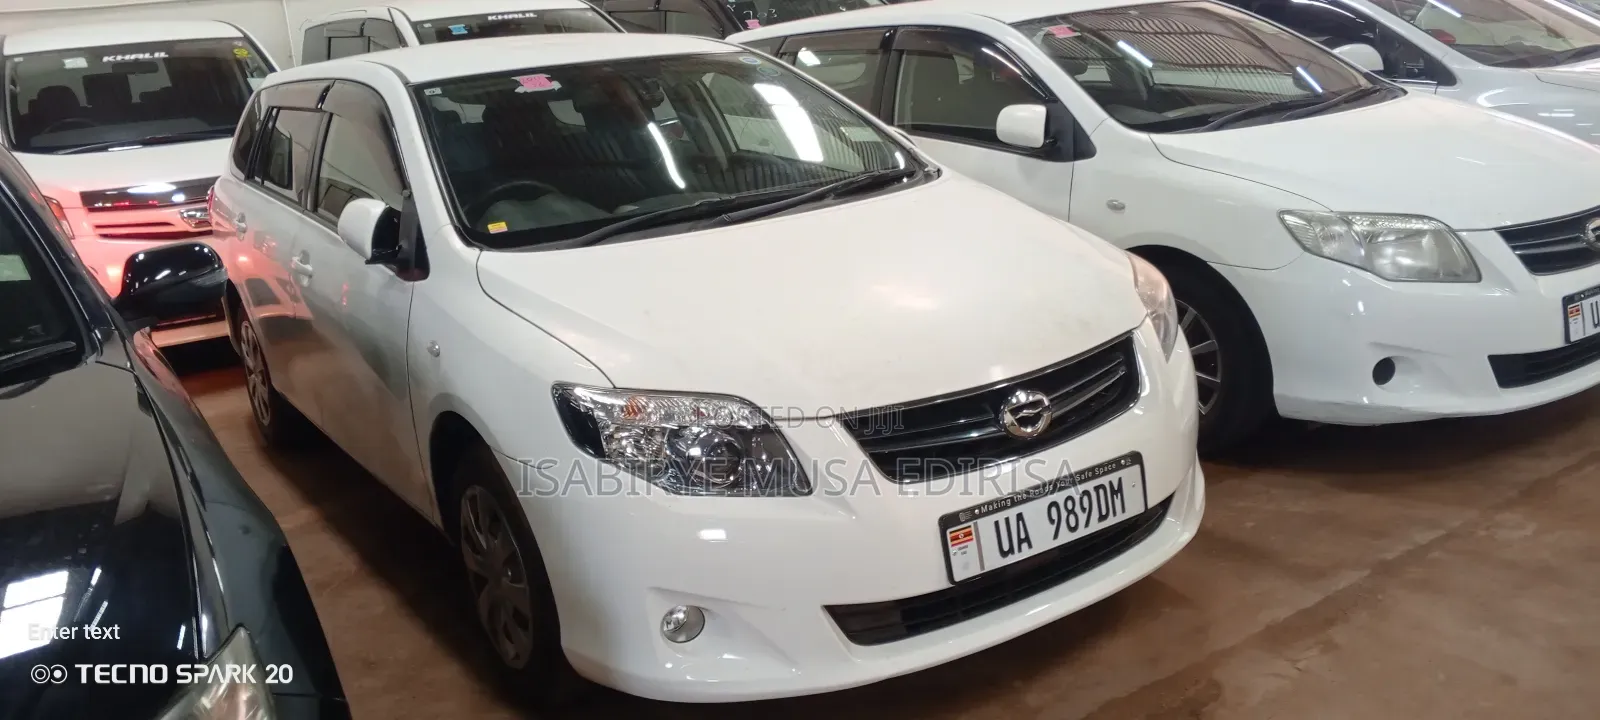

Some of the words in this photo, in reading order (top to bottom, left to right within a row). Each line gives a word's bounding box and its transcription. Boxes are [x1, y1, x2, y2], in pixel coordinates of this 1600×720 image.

[487, 12, 538, 21] KHALIL
[102, 51, 169, 63] KHALIL
[980, 498, 1012, 515] Making
[1013, 492, 1027, 504] the
[1029, 484, 1054, 498] Roads
[1056, 477, 1074, 489] Your
[1075, 471, 1093, 483] Safe
[1095, 463, 1117, 477] Space
[994, 511, 1033, 559] UA
[1046, 476, 1126, 541] 989DM
